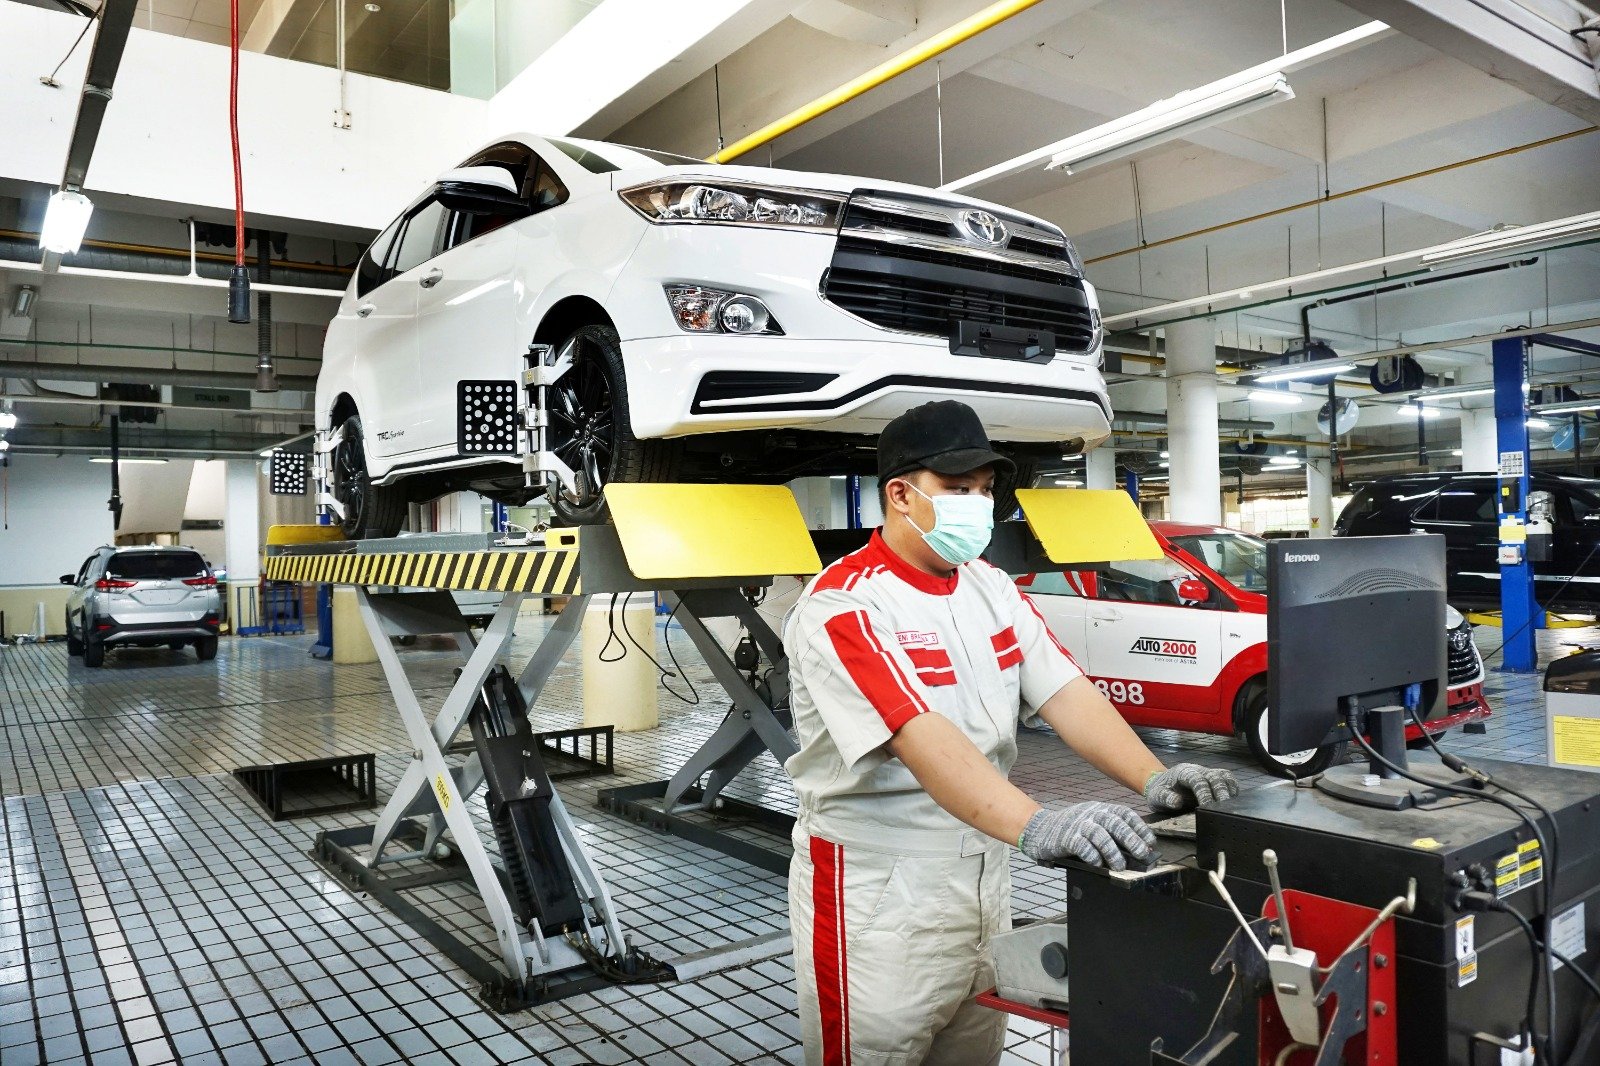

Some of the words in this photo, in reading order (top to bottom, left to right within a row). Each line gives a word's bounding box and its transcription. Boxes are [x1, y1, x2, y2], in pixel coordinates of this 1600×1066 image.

[1285, 553, 1320, 563] lenovo
[1131, 639, 1160, 653] AUTO
[1162, 641, 1197, 655] 2000
